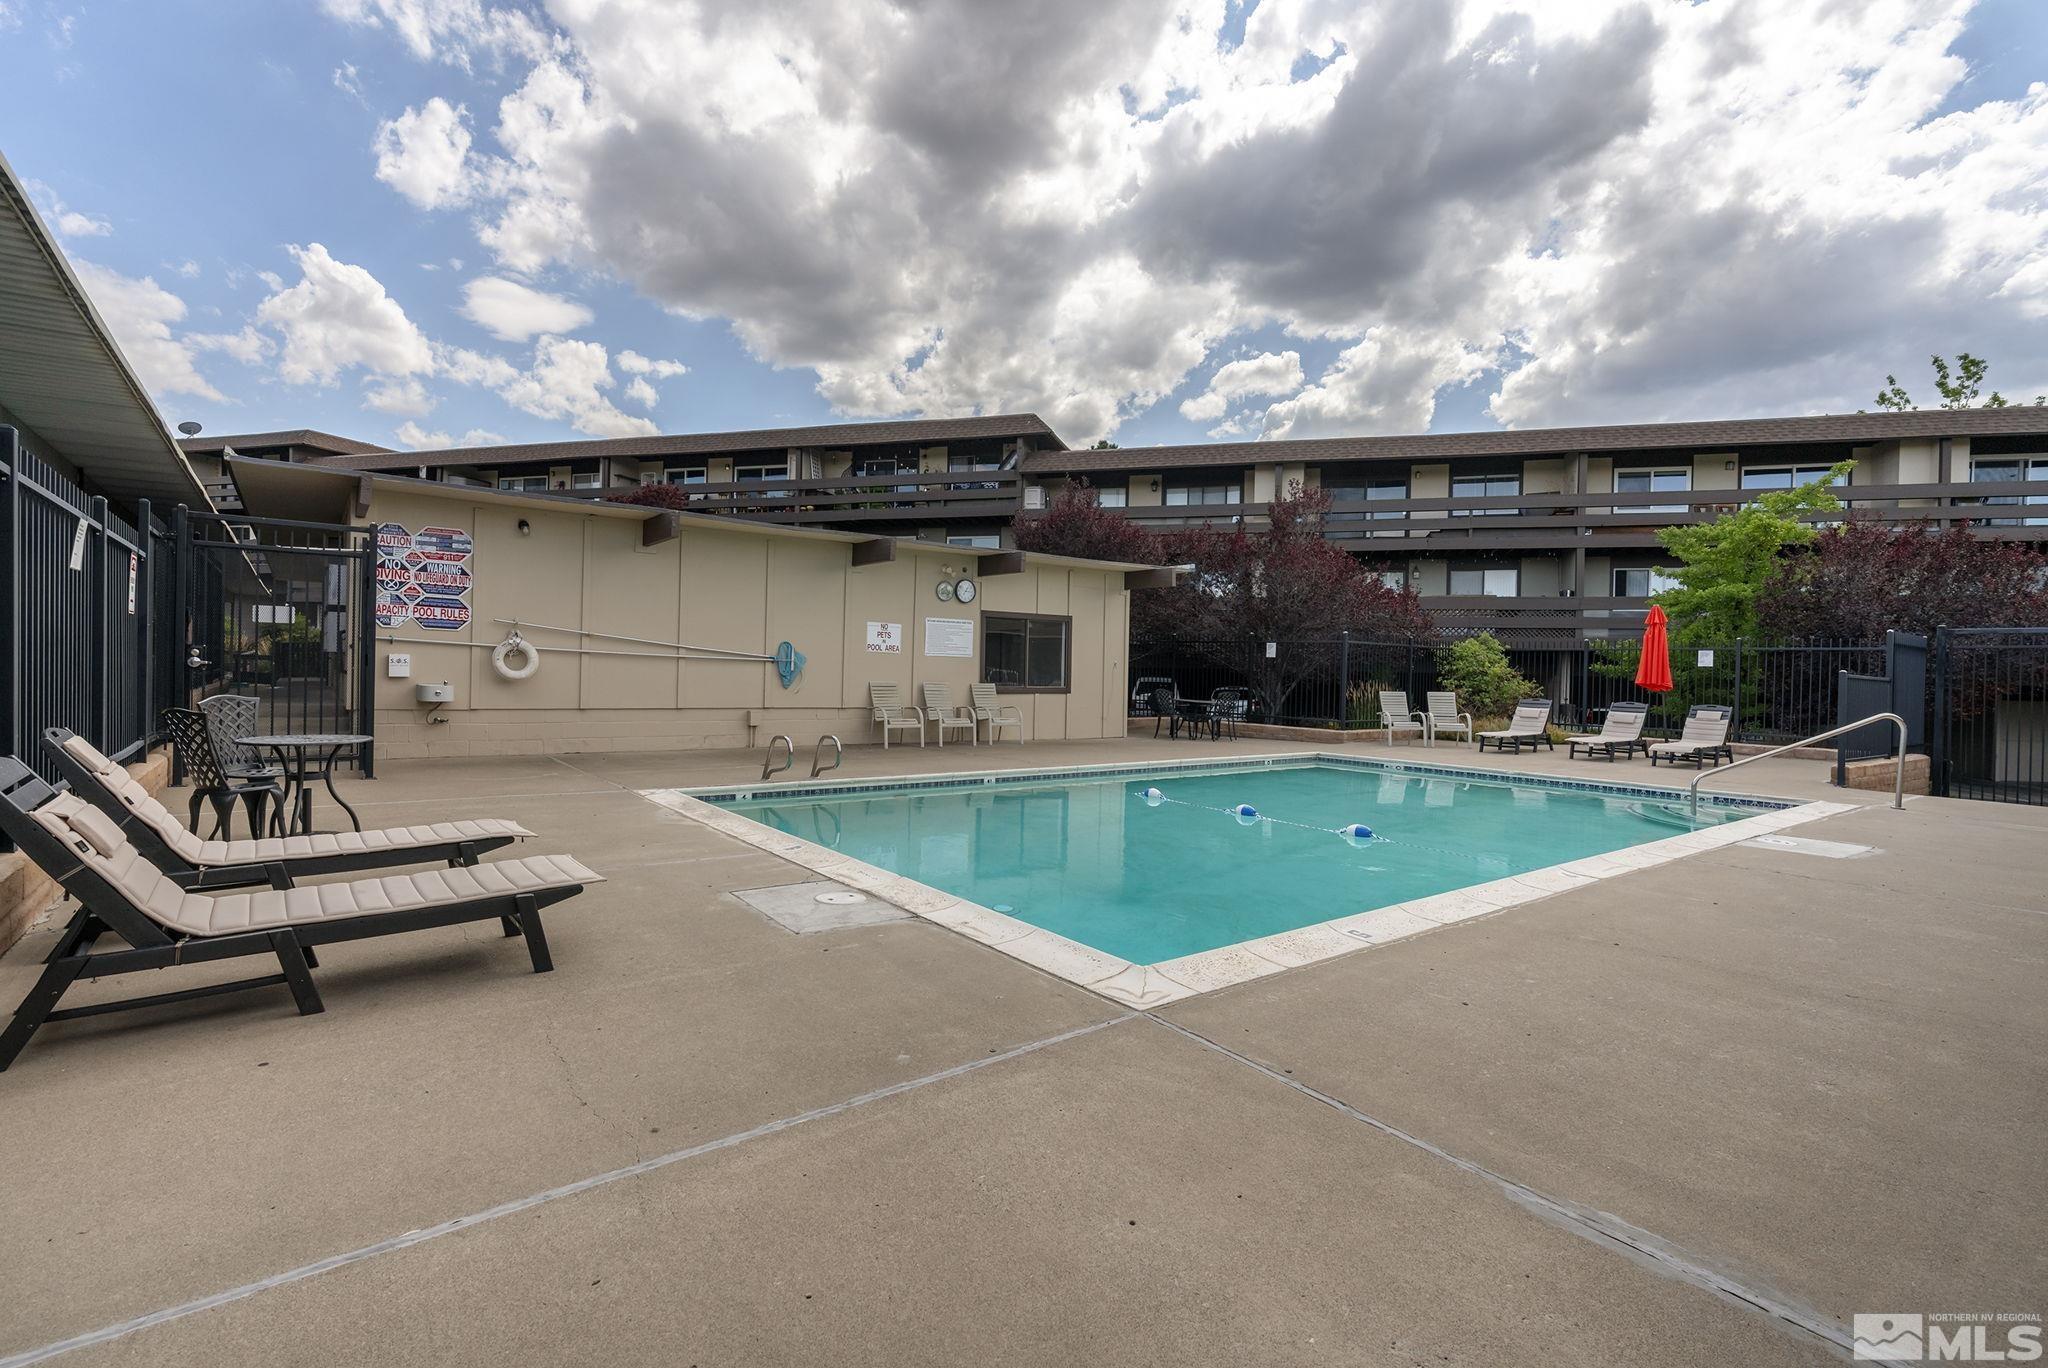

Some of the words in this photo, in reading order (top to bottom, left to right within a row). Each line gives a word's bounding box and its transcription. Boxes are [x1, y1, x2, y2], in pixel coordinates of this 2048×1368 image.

[385, 559, 401, 569] NO
[427, 563, 462, 575] WARNING
[414, 572, 422, 582] NO
[422, 573, 449, 585] LIFEGUARD
[459, 576, 472, 588] DUTY
[376, 604, 409, 615] APACITY
[413, 607, 437, 618] POOL
[440, 609, 470, 620] RULES
[876, 631, 892, 639] PETS
[867, 643, 883, 652] POOL
[885, 645, 900, 653] AREA
